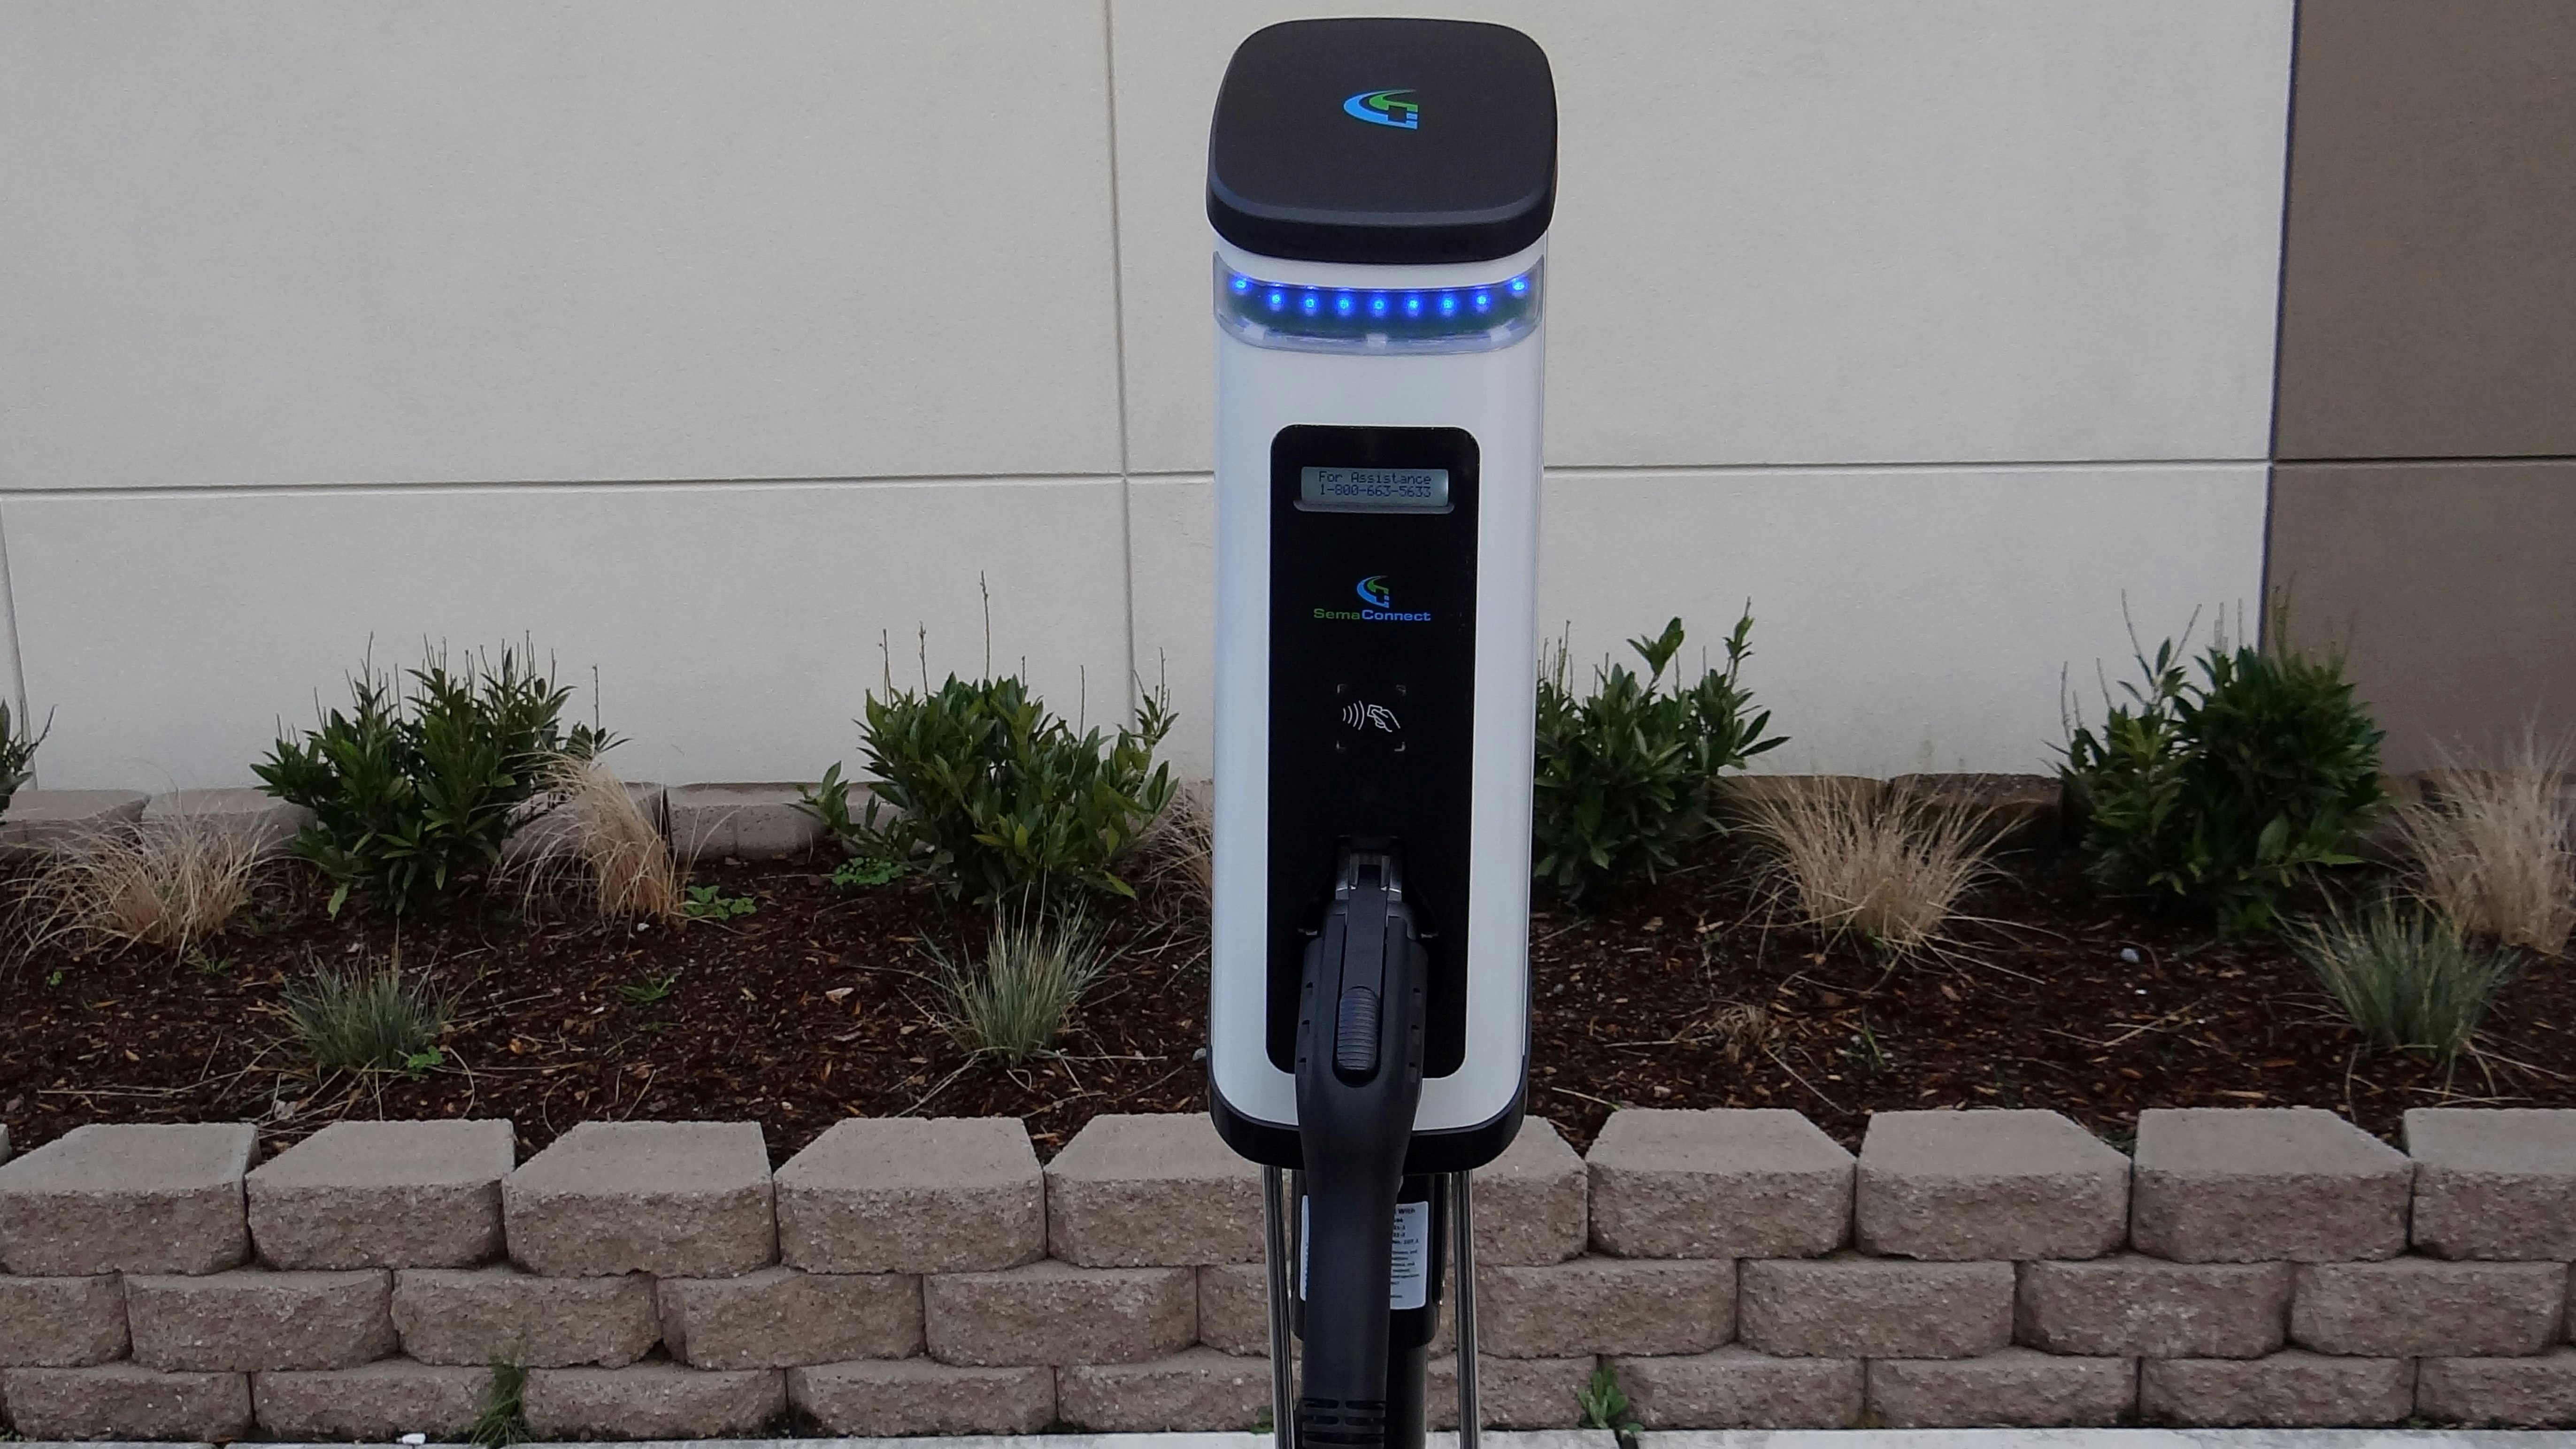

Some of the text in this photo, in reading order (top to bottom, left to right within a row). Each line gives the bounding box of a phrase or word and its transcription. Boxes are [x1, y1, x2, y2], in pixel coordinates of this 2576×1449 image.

[1319, 471, 1432, 485] For Assistance
[1320, 483, 1431, 497] 1-800-663-5633
[1313, 608, 1431, 621] SemaConnect
